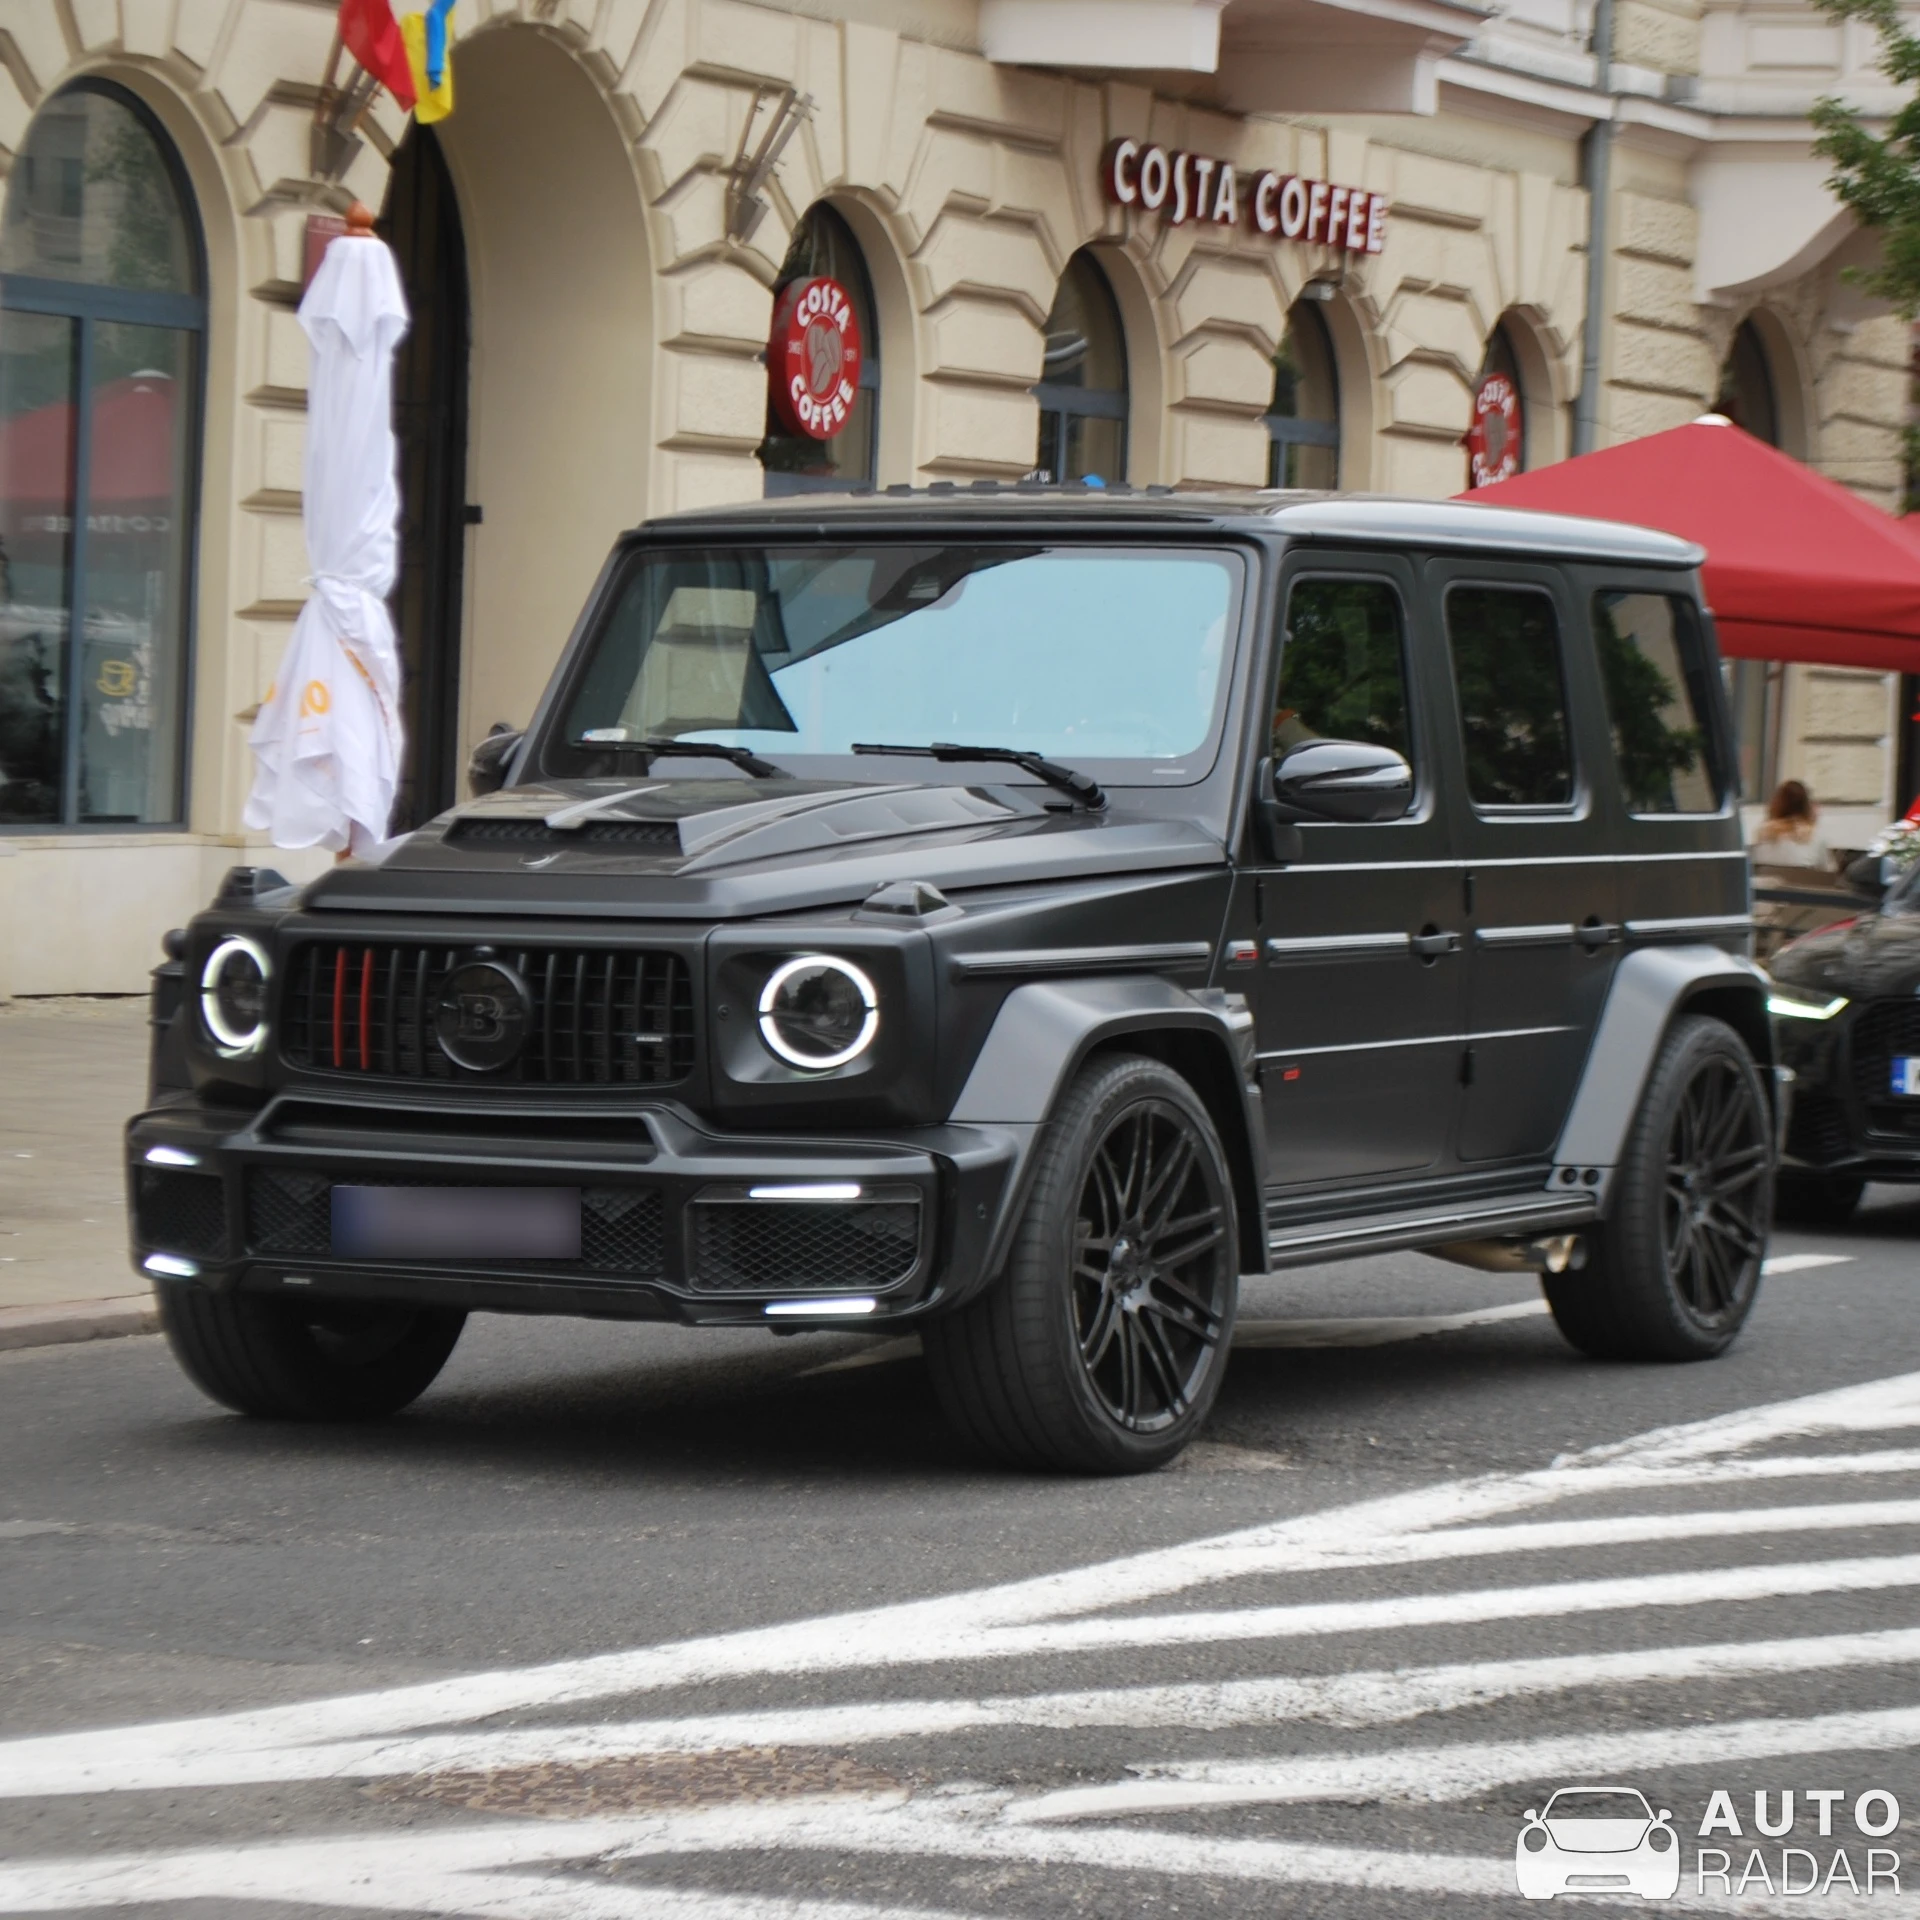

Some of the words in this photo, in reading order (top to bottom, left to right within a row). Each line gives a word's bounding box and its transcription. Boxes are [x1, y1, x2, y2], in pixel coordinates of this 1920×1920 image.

[1112, 137, 1238, 225] COSTA
[1254, 172, 1386, 252] COFFEE
[796, 283, 851, 333] COSTA
[790, 374, 854, 432] COFFEE
